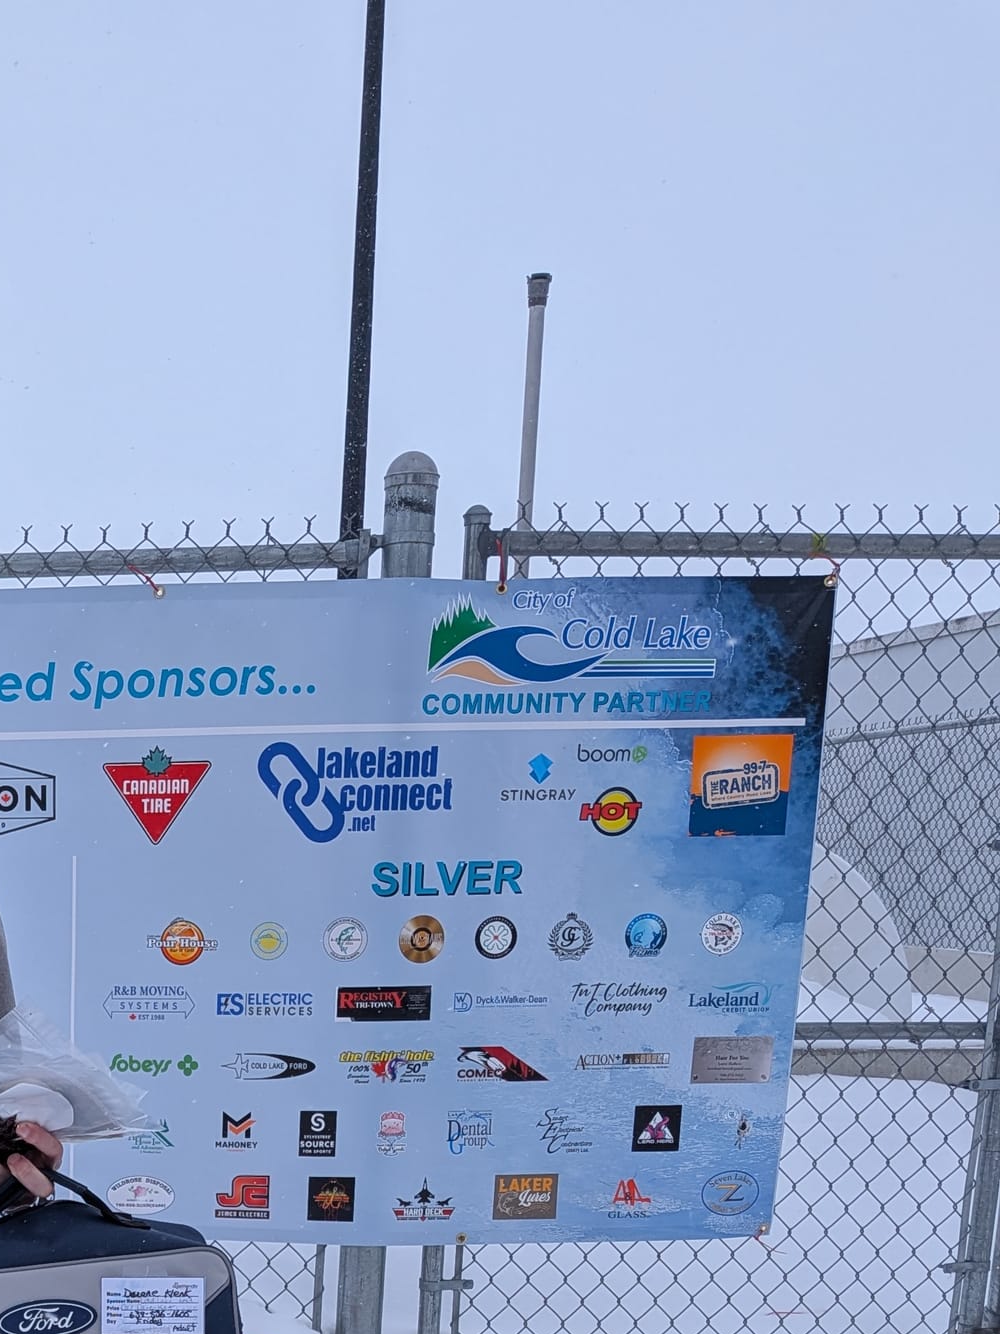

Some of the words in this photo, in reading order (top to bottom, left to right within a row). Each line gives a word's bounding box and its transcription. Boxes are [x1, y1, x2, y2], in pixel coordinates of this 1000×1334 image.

[512, 590, 548, 615] City
[553, 587, 576, 608] of
[562, 615, 638, 649] Cold
[643, 616, 710, 649] Lake
[69, 661, 316, 708] Sponsors...
[422, 692, 584, 714] COMMUNITY
[593, 689, 711, 712] PARTNER
[577, 744, 631, 762] boom
[317, 746, 439, 778] lakeland
[123, 779, 189, 796] CANADIAN
[711, 780, 719, 797] THE
[719, 774, 772, 795] RANCH
[341, 778, 453, 812] connect
[501, 789, 576, 802] STINGRAY
[141, 798, 172, 814] TIRE
[579, 801, 642, 821] HOT
[347, 815, 376, 832] .net
[372, 860, 523, 897] SILVER
[705, 914, 723, 930] COLD
[147, 937, 177, 949] Pour
[178, 937, 219, 949] House
[114, 985, 137, 996] R&B
[140, 985, 185, 996] MOVING
[248, 993, 313, 1005] ELECTRIC
[604, 981, 668, 1002] Clothing
[120, 1001, 178, 1010] SYSTEMS
[339, 991, 406, 1009] REGISTRY
[354, 1001, 395, 1009] TRI-TOWN
[585, 999, 653, 1018] Company
[688, 992, 760, 1009] Lakeland
[248, 1006, 313, 1016] SERVICES
[339, 1050, 362, 1062] the
[405, 1050, 435, 1062] hole
[109, 1053, 172, 1077] Sobeys
[251, 1062, 268, 1070] COLD
[268, 1062, 285, 1070] LAKE
[289, 1062, 308, 1070] FORD
[310, 1112, 326, 1132] S
[446, 1118, 493, 1142] Dental
[215, 1141, 258, 1149] MAHONEY
[299, 1140, 335, 1148] SOURCE
[449, 1132, 488, 1155] Group
[111, 1177, 143, 1192] WILDROSE
[145, 1177, 173, 1195] DISPOSAL
[499, 1178, 553, 1192] LAKER
[708, 1174, 733, 1187] Seven
[518, 1190, 551, 1207] Lures
[404, 1207, 424, 1217] HARD
[425, 1207, 444, 1217] DECK
[607, 1210, 648, 1218] GLASS
[18, 1307, 74, 1333] Ford
